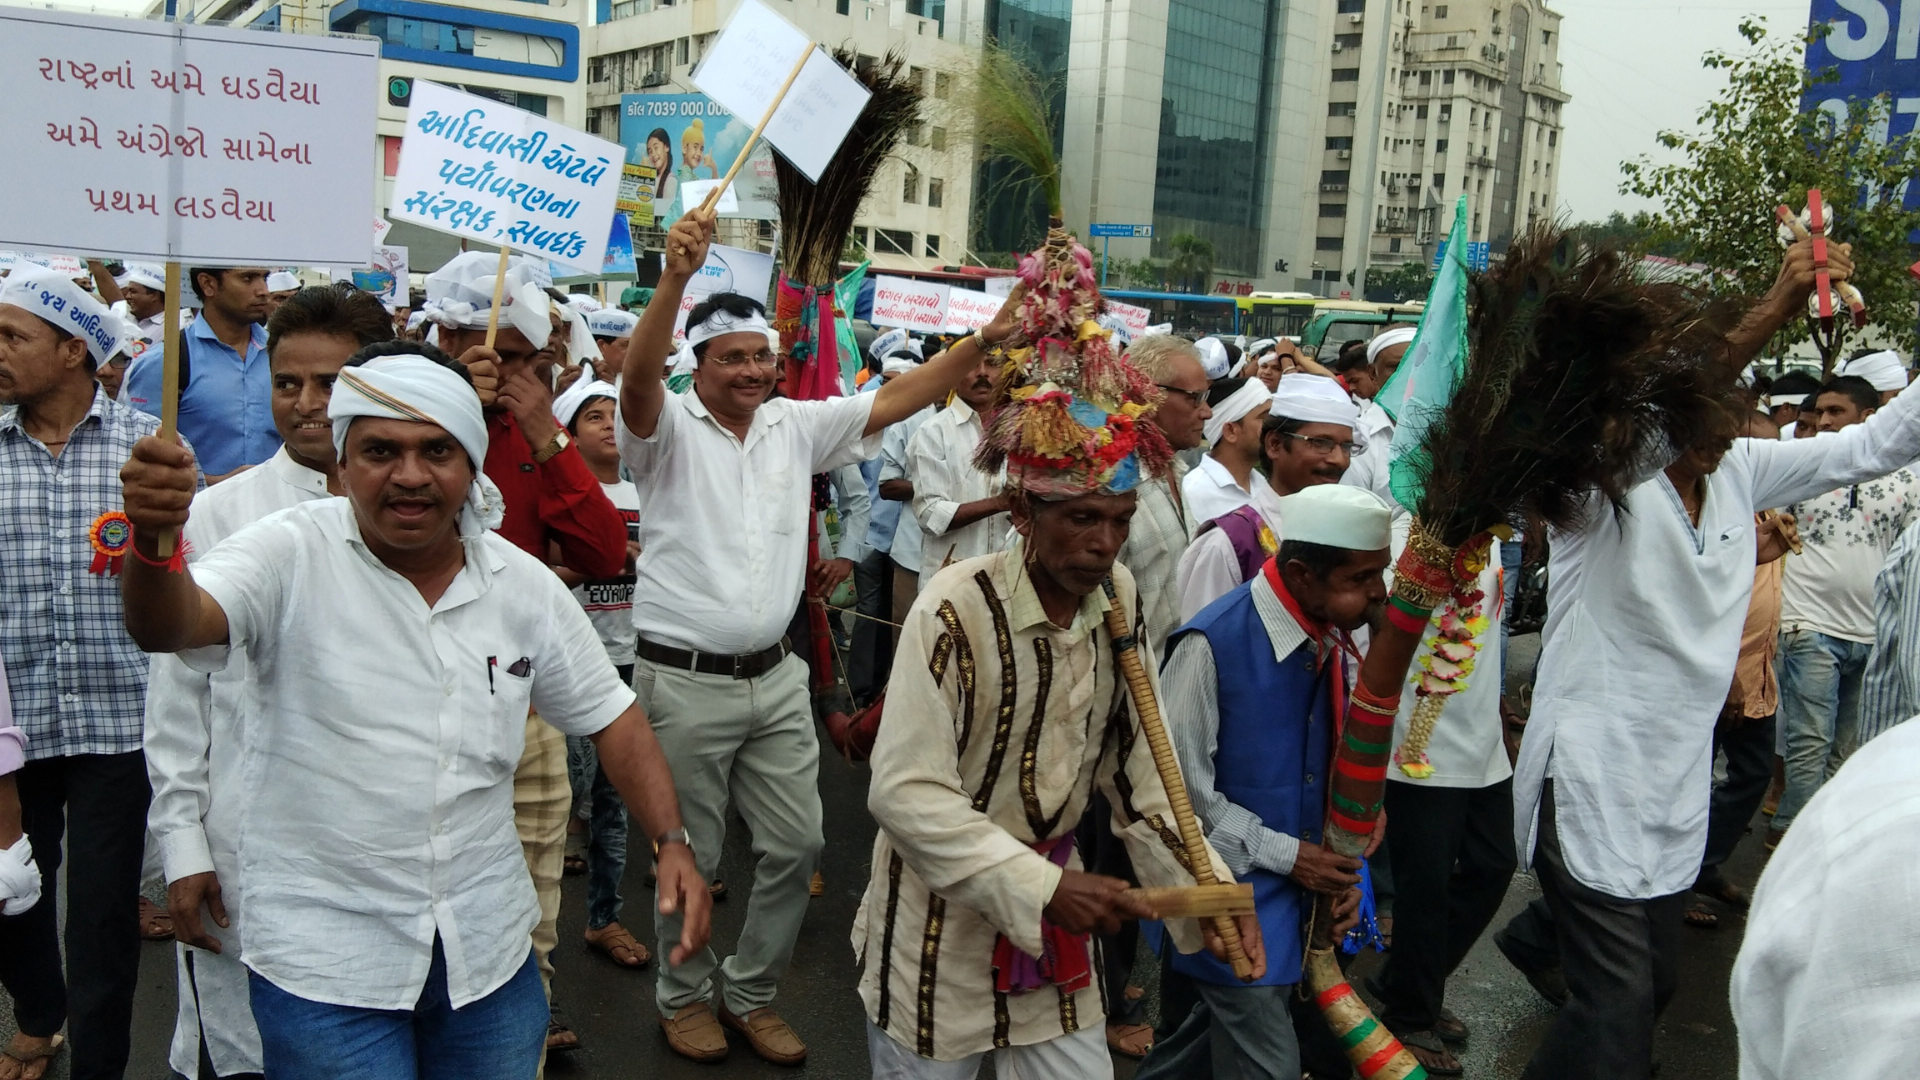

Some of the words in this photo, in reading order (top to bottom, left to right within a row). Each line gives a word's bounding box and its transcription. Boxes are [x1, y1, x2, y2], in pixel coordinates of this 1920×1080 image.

[39, 57, 135, 90] રાષ્ટ્રનાં
[151, 64, 205, 96] અમે
[221, 68, 320, 105] ઘડવૈયા
[647, 101, 677, 116] 7039
[680, 101, 704, 116] 000
[47, 117, 102, 150] અમે
[117, 124, 208, 158] અંગ્રેજો
[222, 132, 312, 165] સામેના
[417, 109, 548, 164] આદિવાસી
[85, 187, 159, 216] પ્રથમ
[174, 187, 276, 222] લડવૈયા
[705, 265, 726, 273] water
[706, 269, 721, 278] LIFE
[877, 288, 902, 302] જંગલ
[903, 292, 940, 309] બચાવો
[70, 306, 116, 354] આદિવાસી
[874, 304, 916, 321] આદિવાસી
[914, 311, 944, 327] બચાવો
